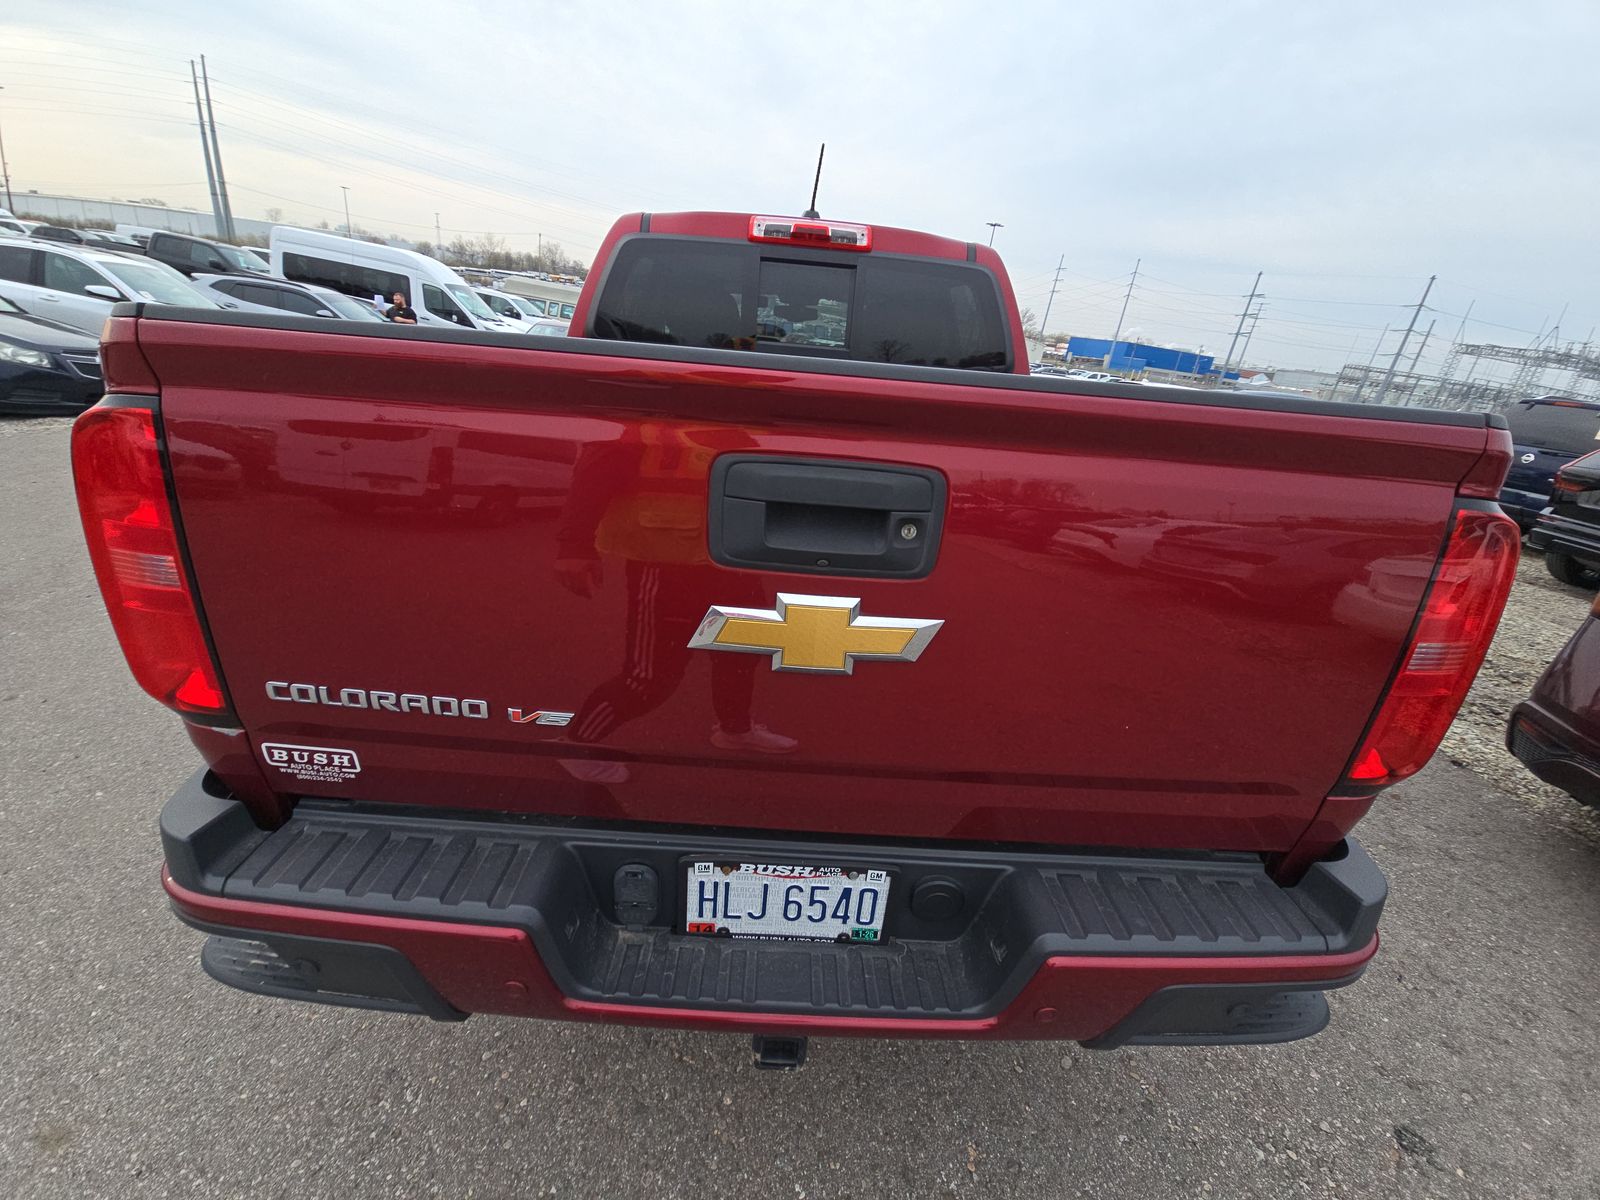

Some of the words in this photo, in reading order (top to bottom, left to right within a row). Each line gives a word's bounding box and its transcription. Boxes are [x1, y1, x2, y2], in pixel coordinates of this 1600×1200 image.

[265, 680, 488, 719] COLORADO
[507, 707, 575, 726] V6
[271, 749, 351, 766] BUSH
[738, 863, 815, 877] BUSH
[698, 880, 769, 920] HLJ
[782, 884, 879, 926] 6540
